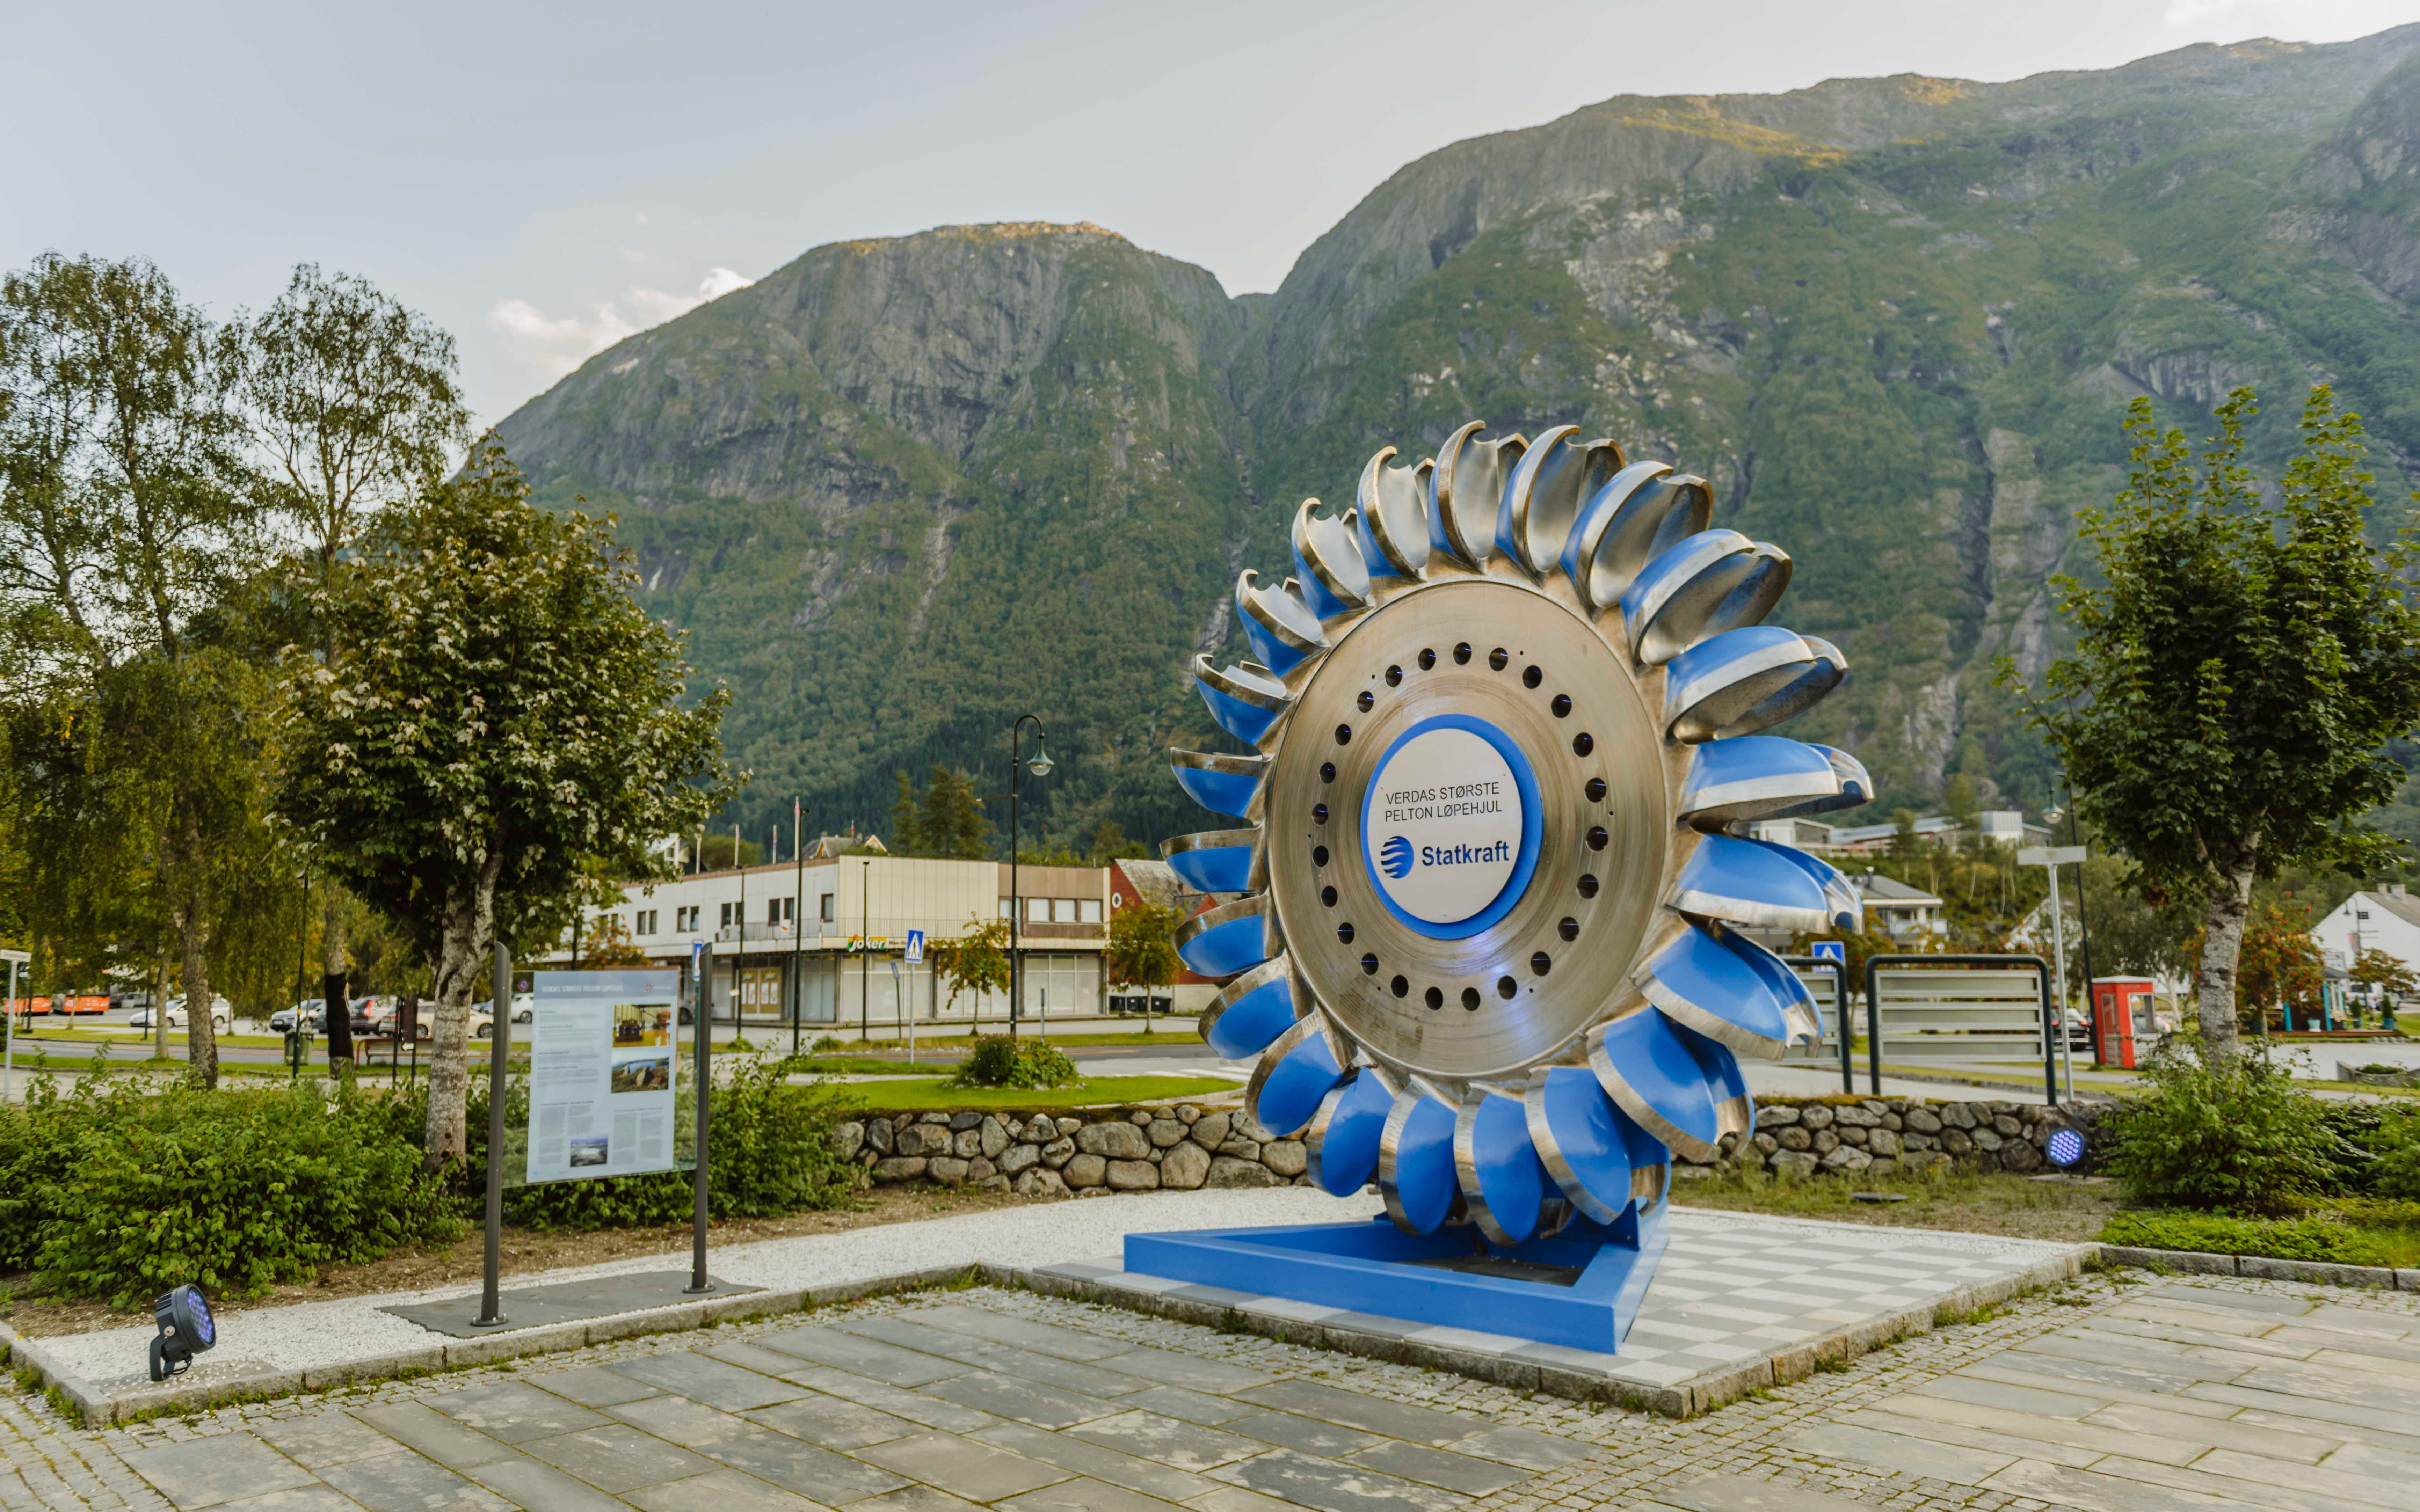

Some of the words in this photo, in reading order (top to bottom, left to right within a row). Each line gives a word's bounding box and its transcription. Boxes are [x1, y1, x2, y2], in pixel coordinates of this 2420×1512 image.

[1386, 789, 1436, 805] VERDAS
[1440, 782, 1499, 800] STØRSTE
[1385, 806, 1433, 822] PELTON
[1437, 800, 1502, 818] LØPEHJUL
[1422, 840, 1510, 867] Statkraft
[849, 934, 885, 952] joker
